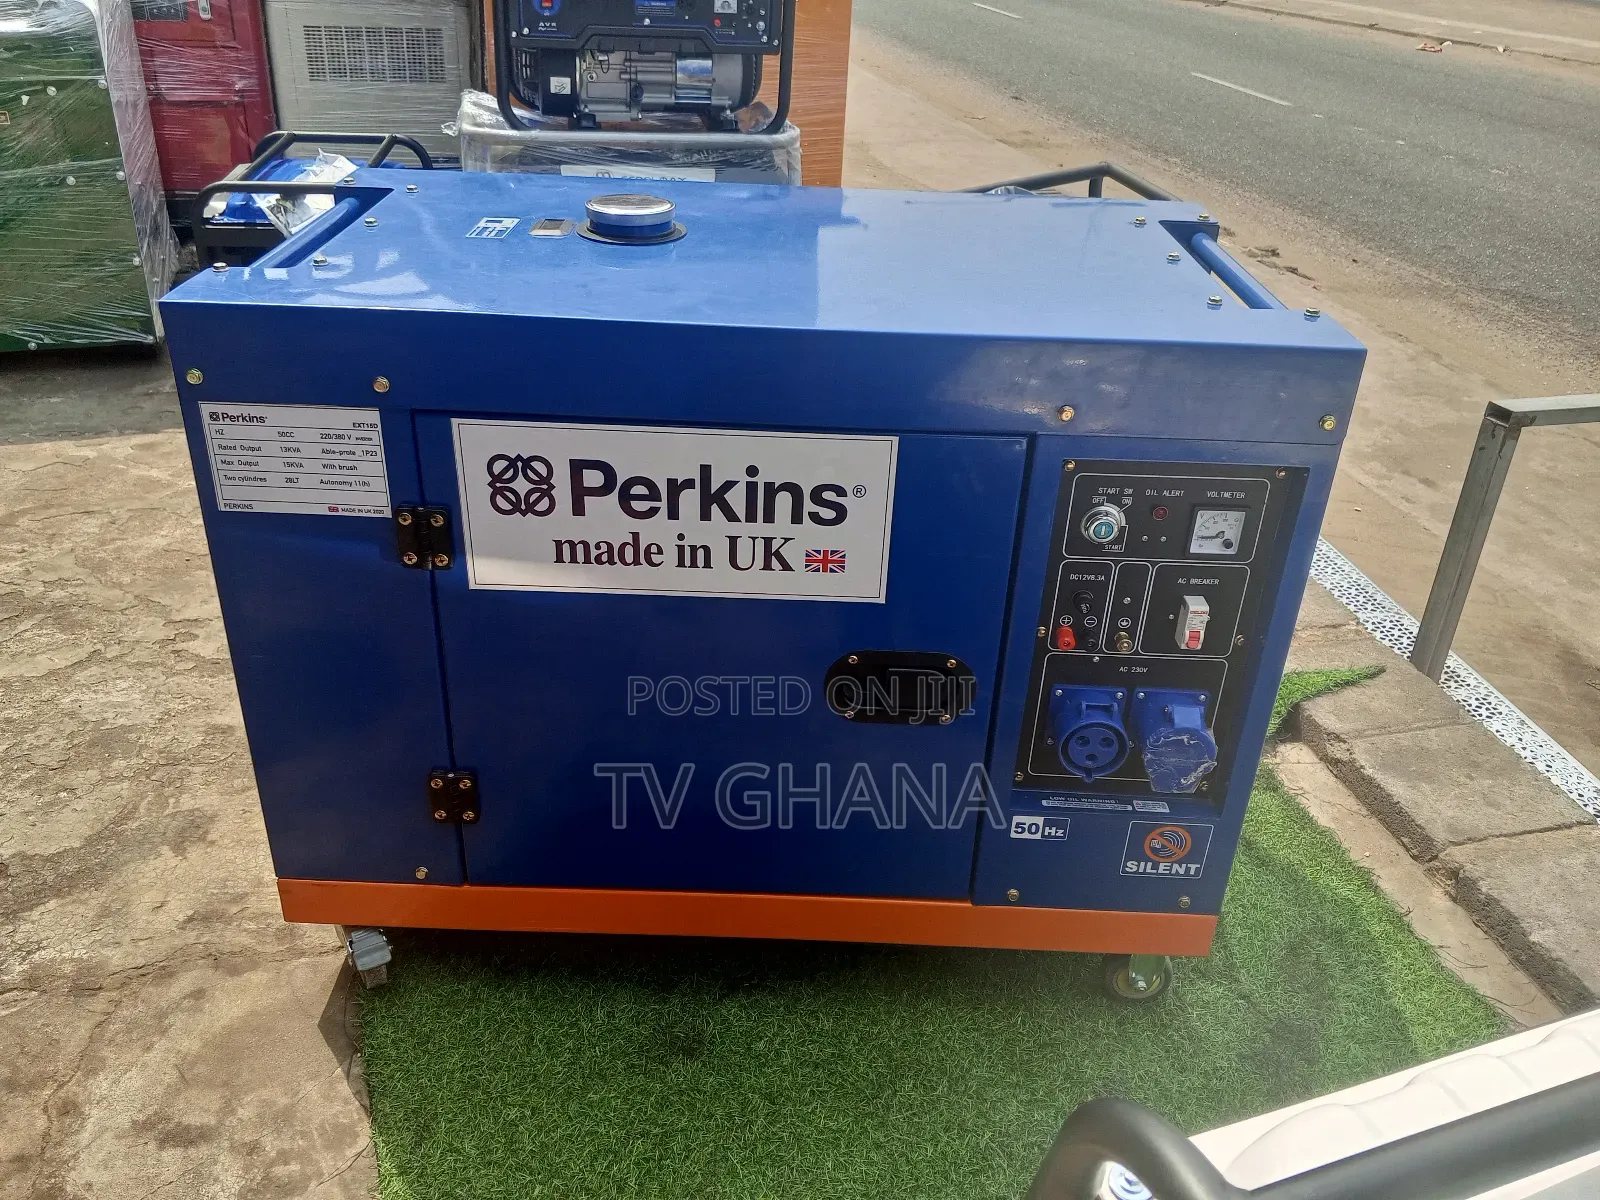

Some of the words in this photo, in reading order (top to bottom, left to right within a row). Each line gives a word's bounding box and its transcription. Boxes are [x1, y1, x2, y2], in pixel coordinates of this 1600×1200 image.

[238, 459, 260, 467] Output
[320, 479, 352, 487] Autonomy
[1207, 491, 1246, 499] VOLTMETER
[553, 532, 664, 568] made
[674, 533, 714, 570] in
[724, 535, 796, 572] UK
[1013, 822, 1040, 835] 50
[1044, 826, 1064, 837] Hz
[1125, 861, 1200, 875] SILENT
